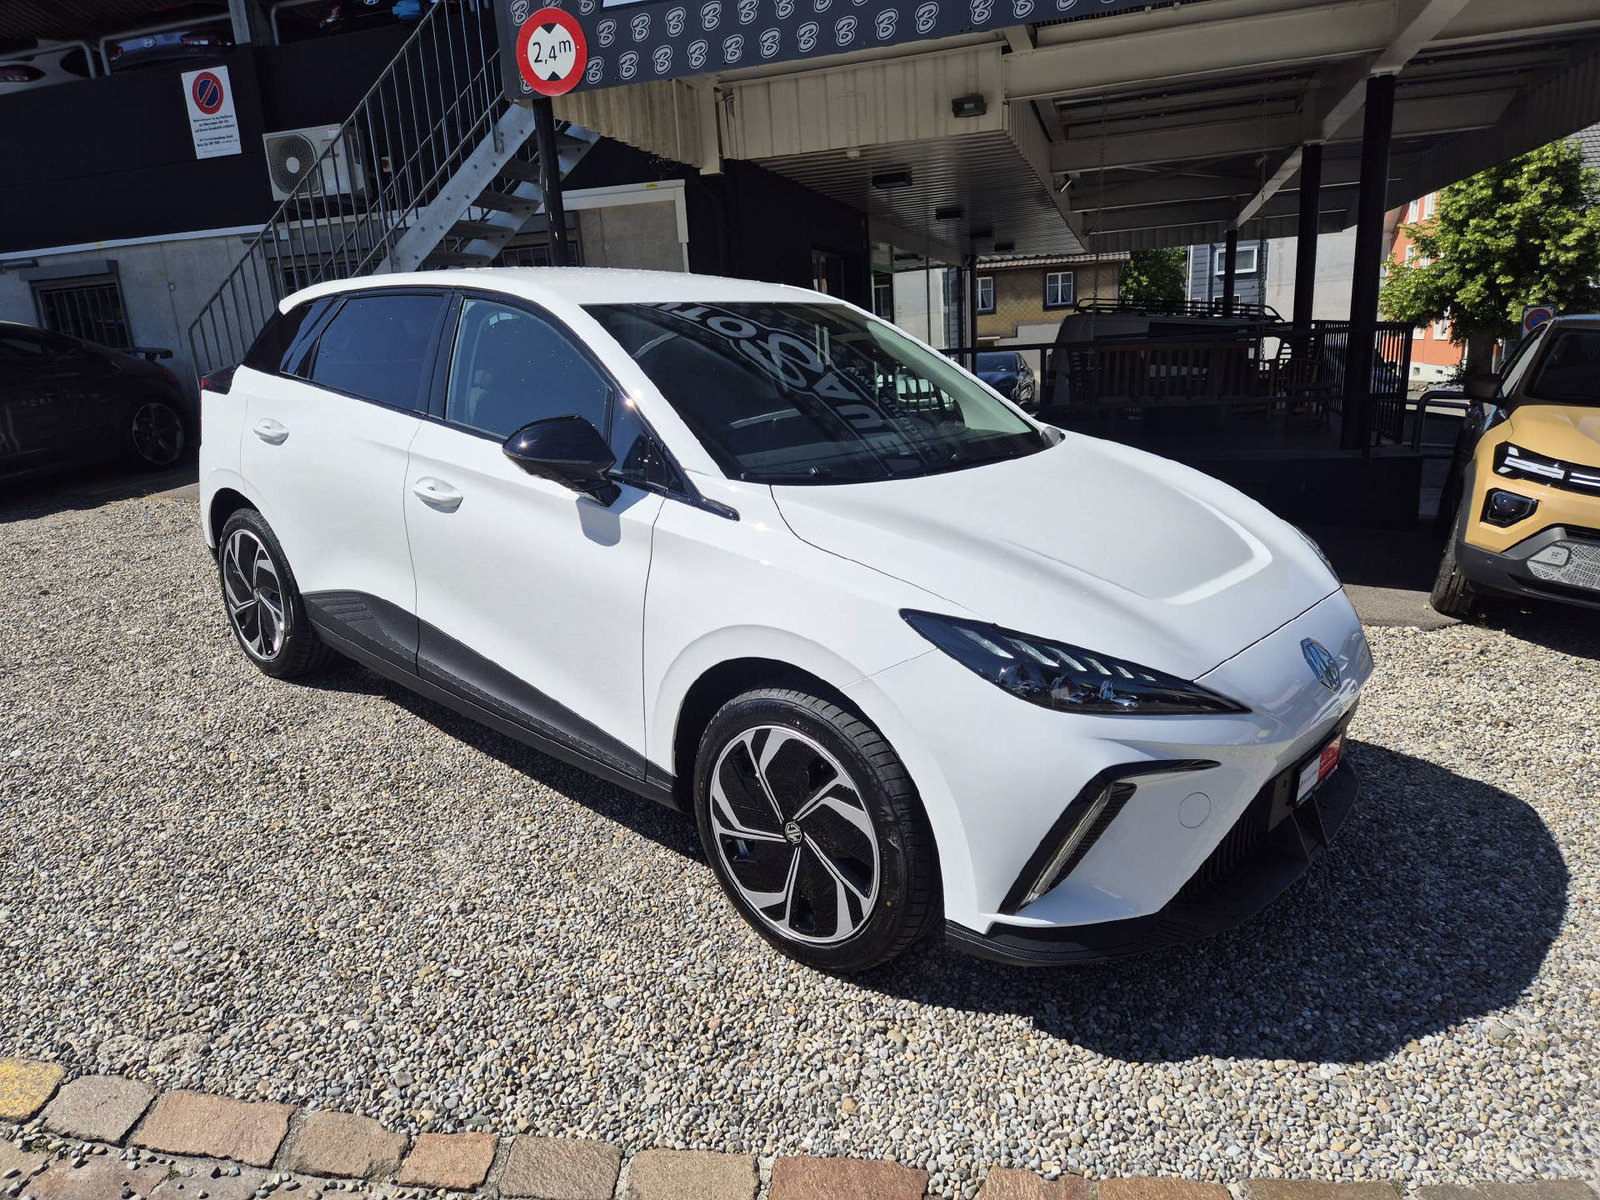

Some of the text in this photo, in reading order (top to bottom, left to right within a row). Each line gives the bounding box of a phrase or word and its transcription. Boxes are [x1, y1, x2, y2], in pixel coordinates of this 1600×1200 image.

[586, 2, 939, 84] B B B B B B B B B B
[597, 19, 617, 47] B
[631, 13, 651, 42] B
[665, 7, 686, 37] B
[700, 1, 722, 31] B
[786, 823, 802, 842] MG
